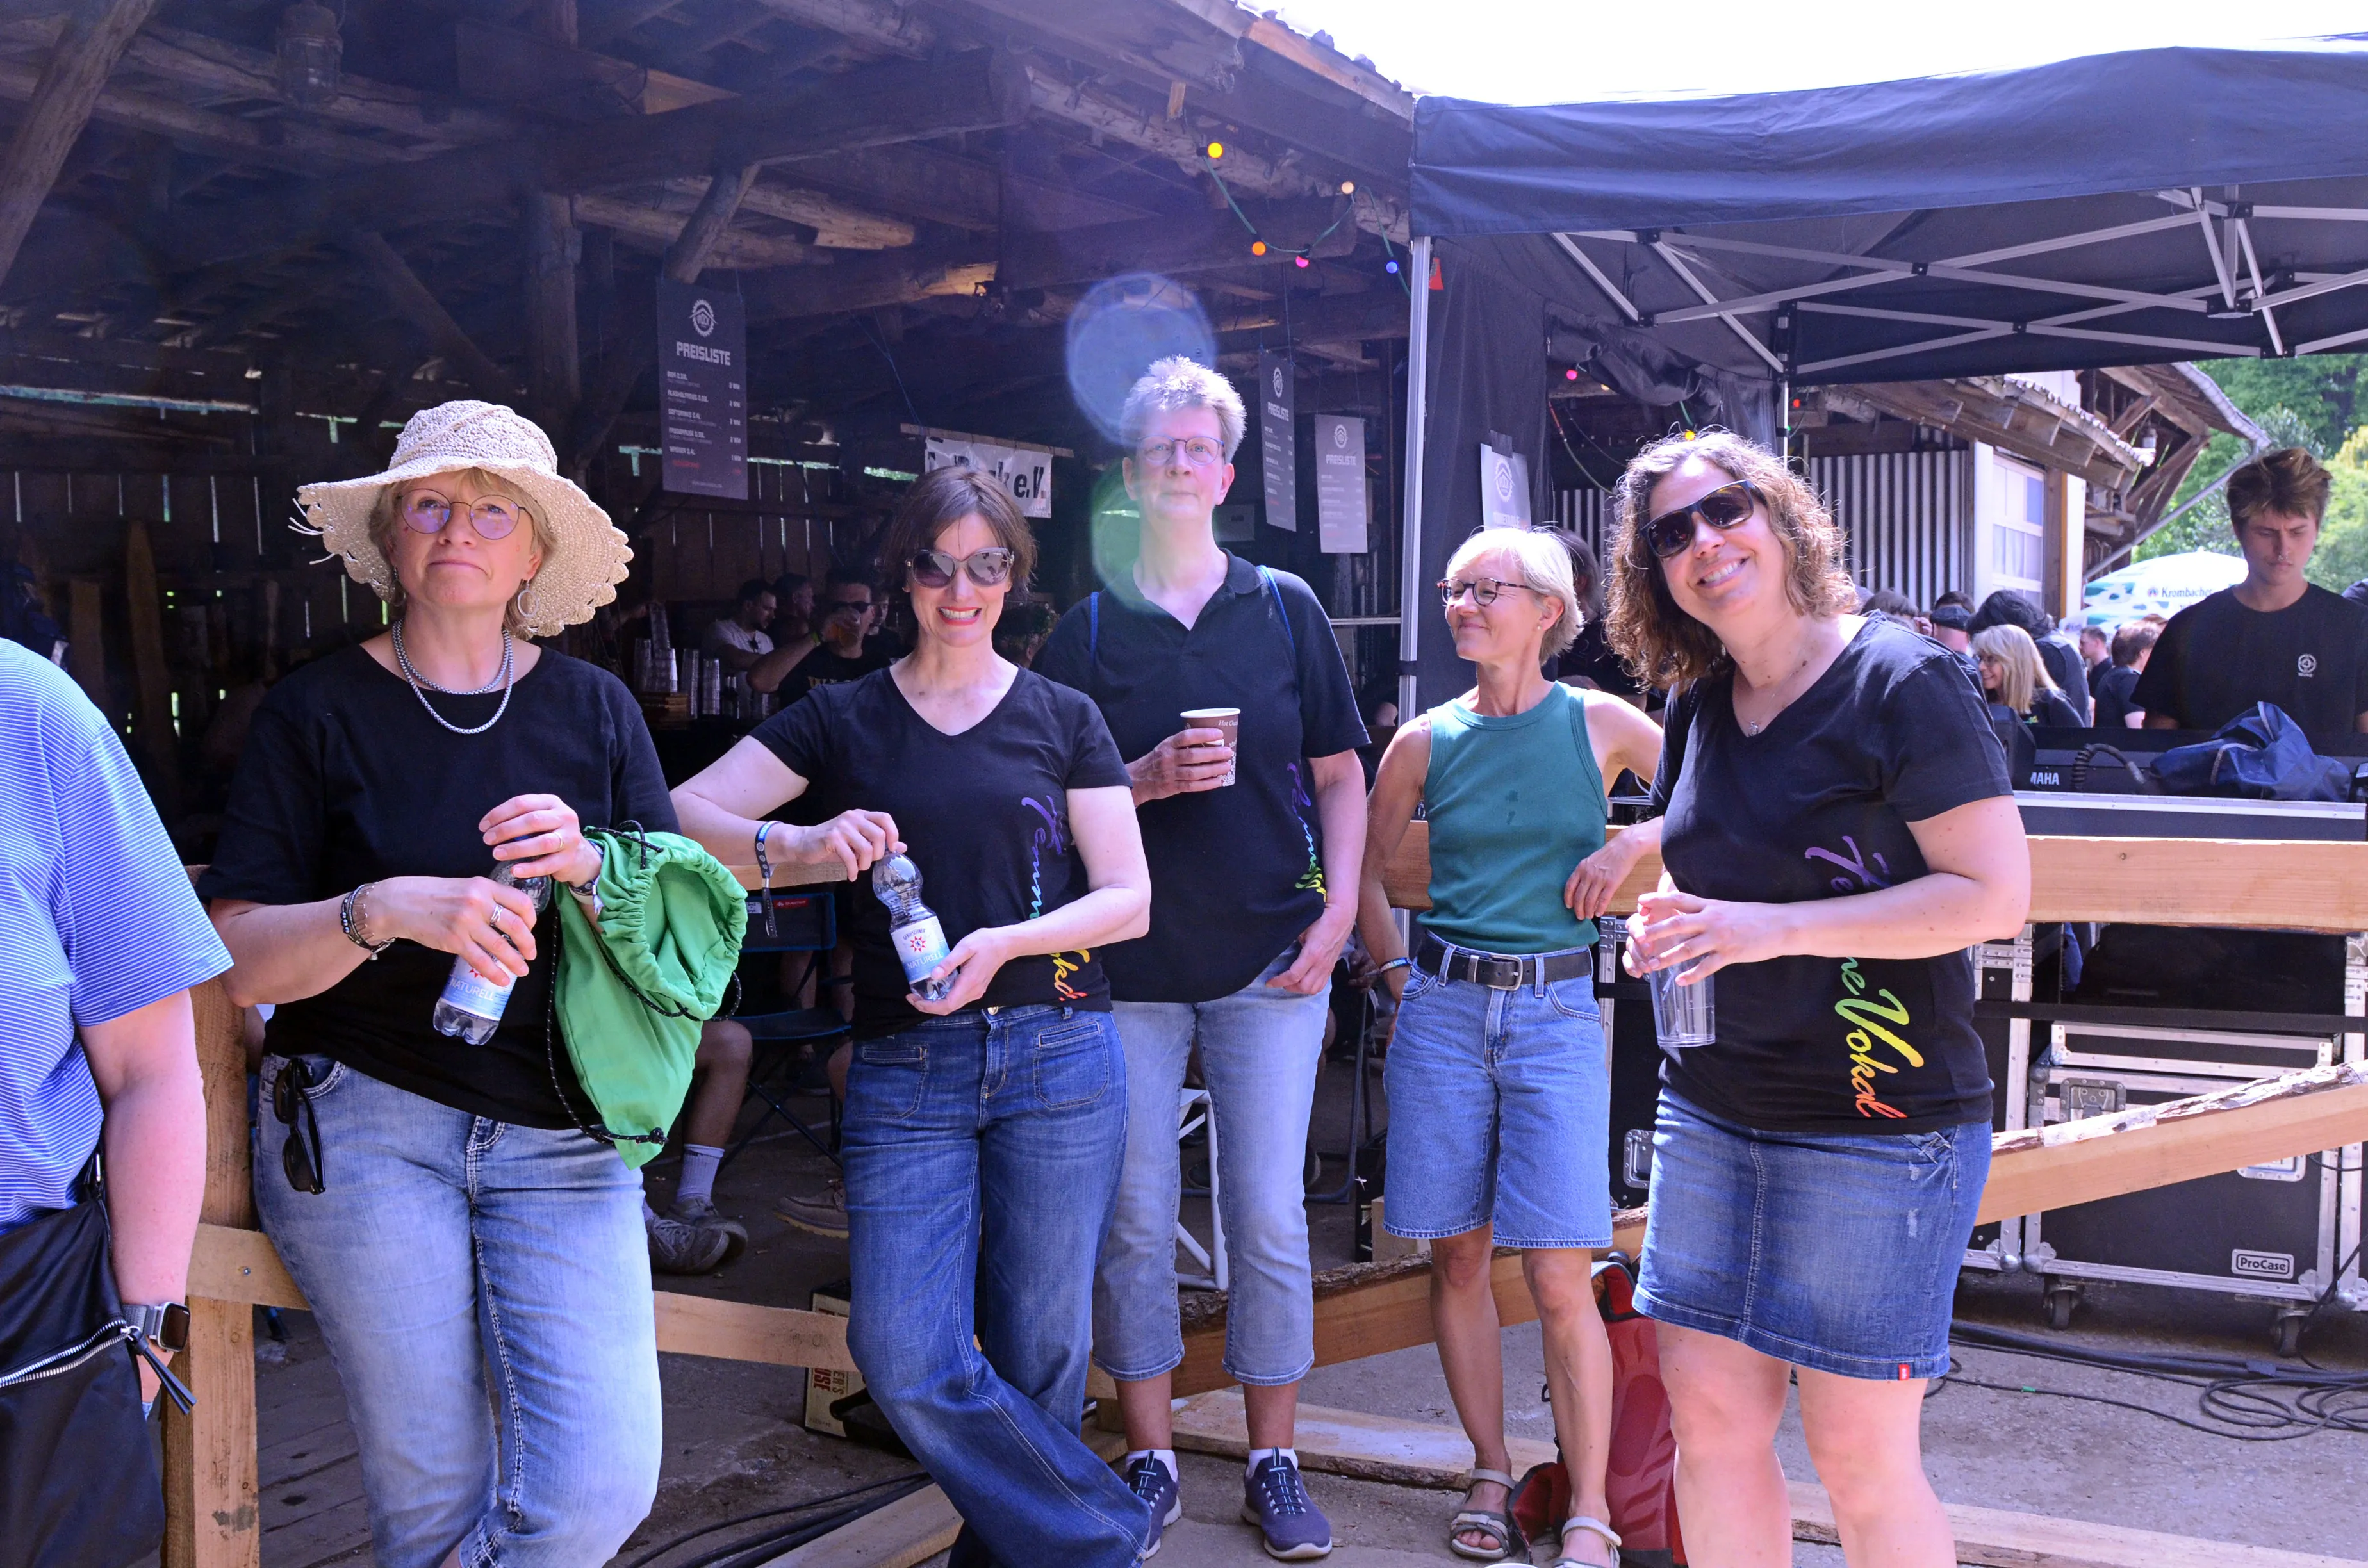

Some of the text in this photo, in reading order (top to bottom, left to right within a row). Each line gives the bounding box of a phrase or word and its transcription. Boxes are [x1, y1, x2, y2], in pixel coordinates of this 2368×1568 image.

[677, 341, 731, 366] PREISLISTE
[1268, 401, 1289, 422] PREISLISTE
[1326, 454, 1357, 466] PREISLISTE
[2162, 586, 2212, 598] Krombacher
[2030, 772, 2059, 785] MAHA
[907, 951, 944, 969] NATURELL
[449, 977, 494, 1000] NATURELL
[1834, 988, 1924, 1119] Vokal
[2241, 1257, 2286, 1271] ProCase
